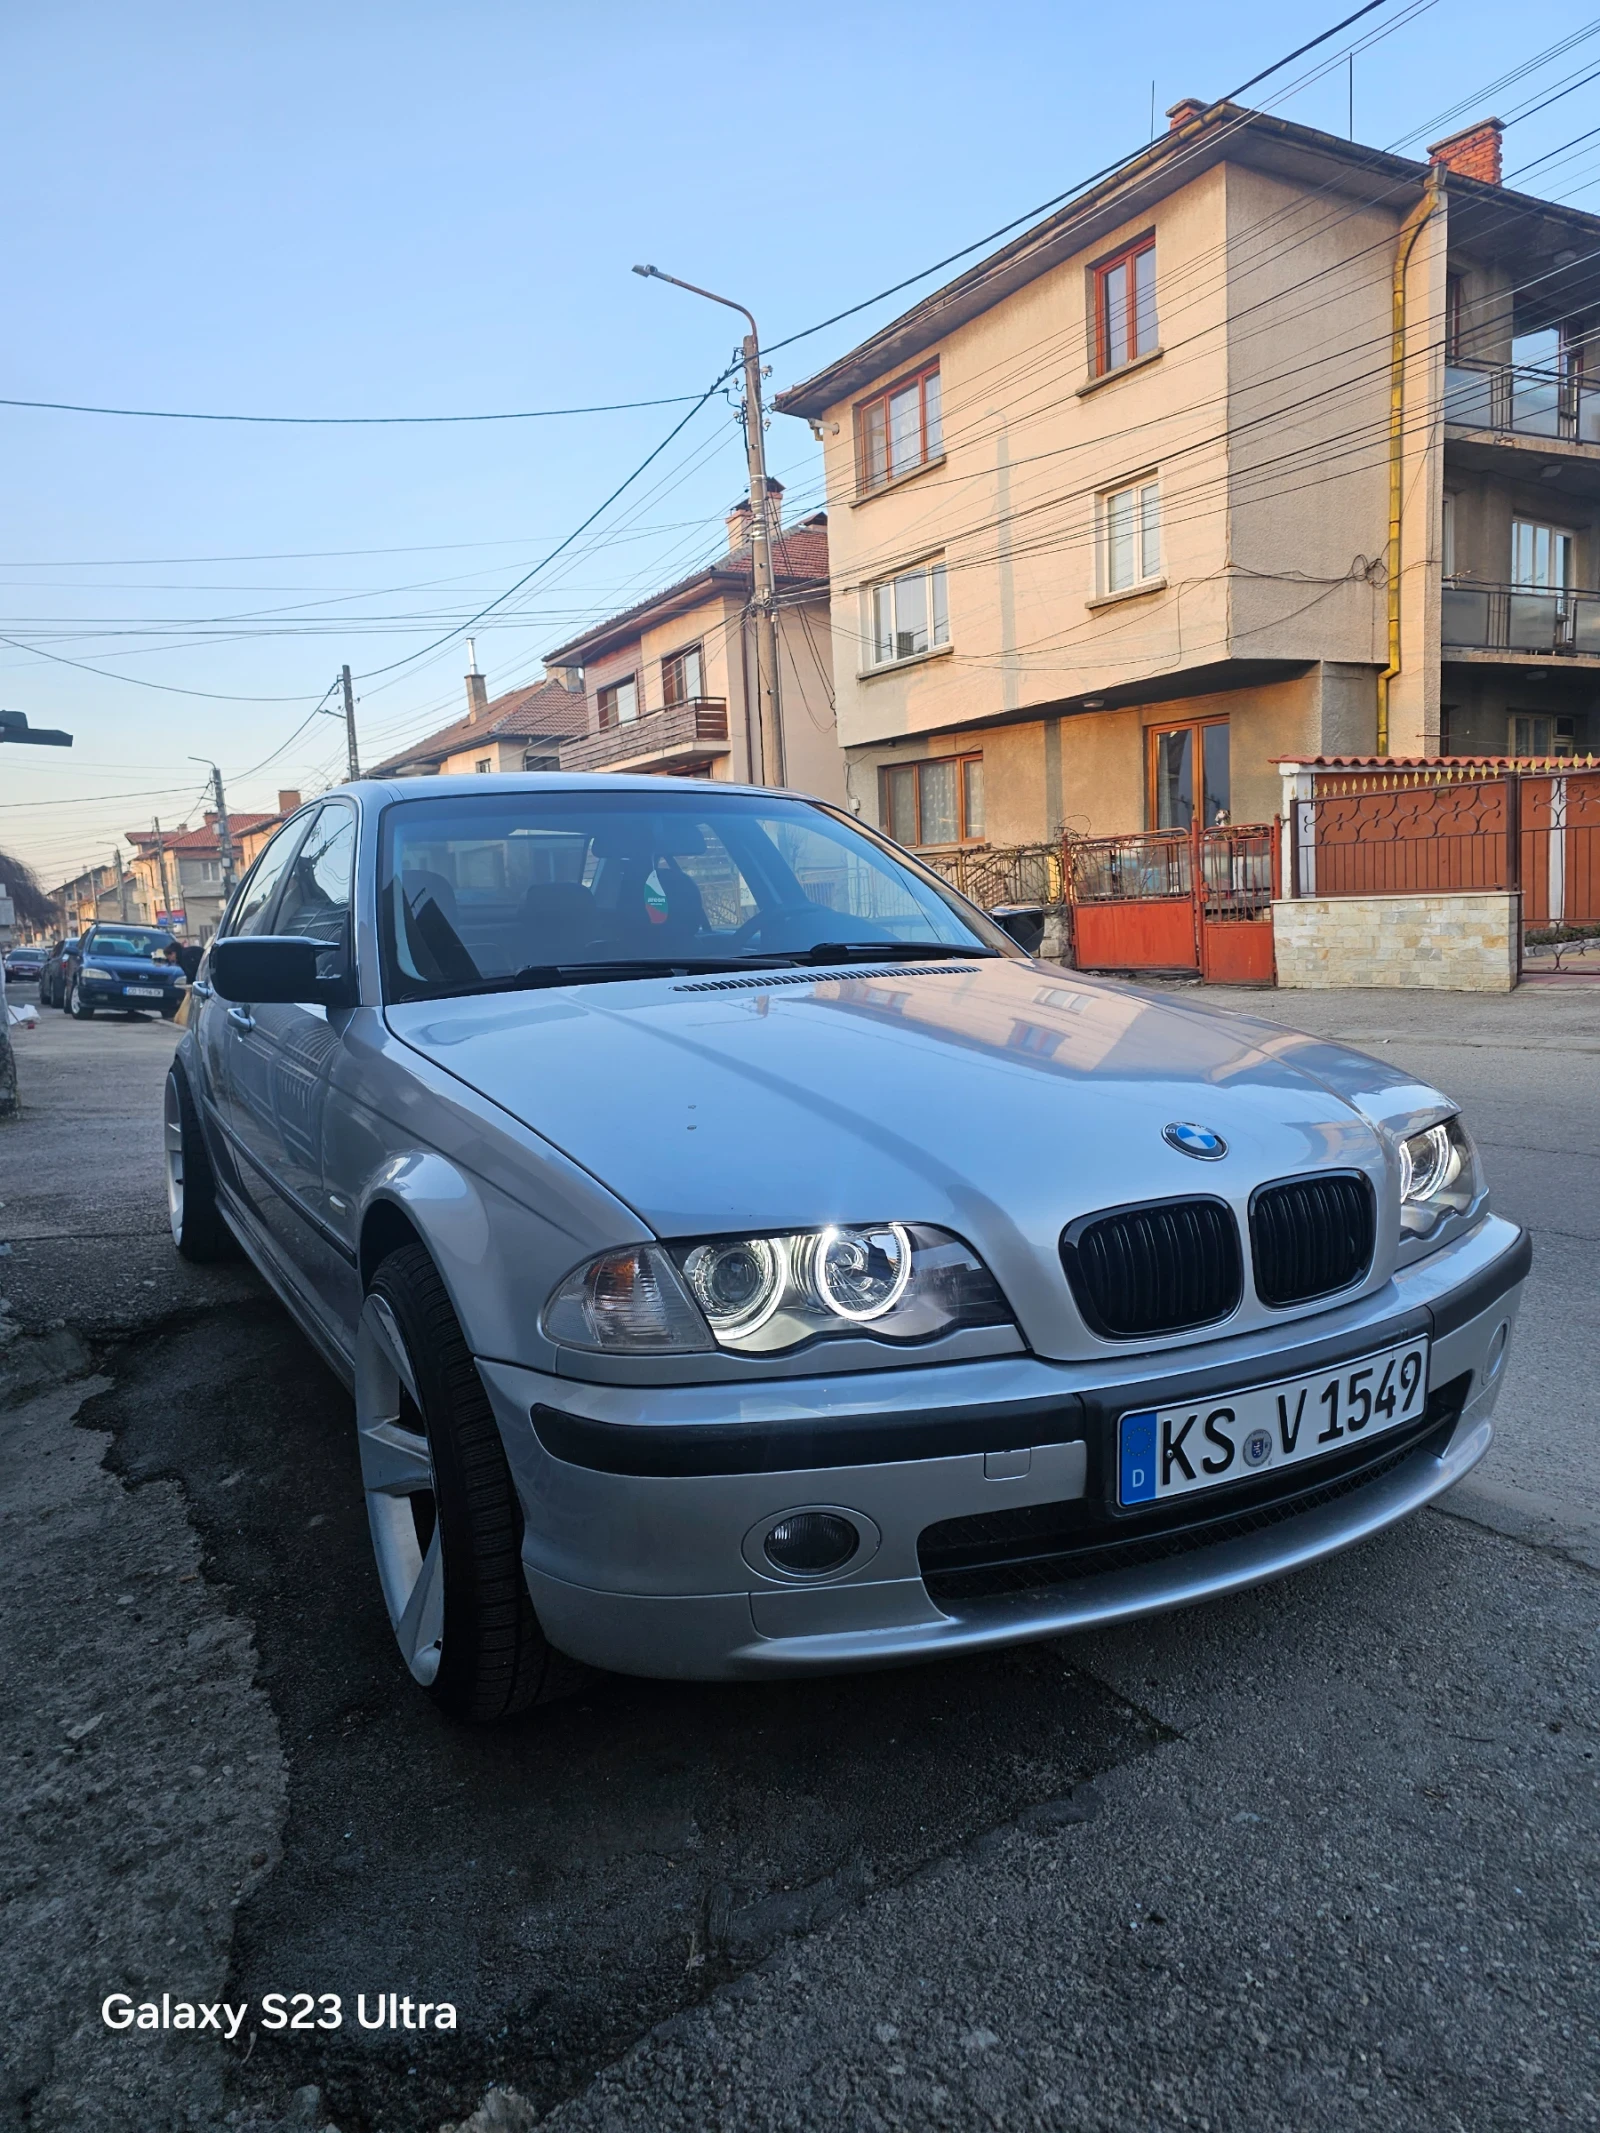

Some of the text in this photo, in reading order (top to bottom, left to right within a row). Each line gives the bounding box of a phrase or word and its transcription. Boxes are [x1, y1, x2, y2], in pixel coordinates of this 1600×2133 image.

[1162, 1407, 1236, 1486] KS
[1277, 1388, 1308, 1454] V
[1317, 1350, 1423, 1445] 1549
[1132, 1469, 1145, 1488] D
